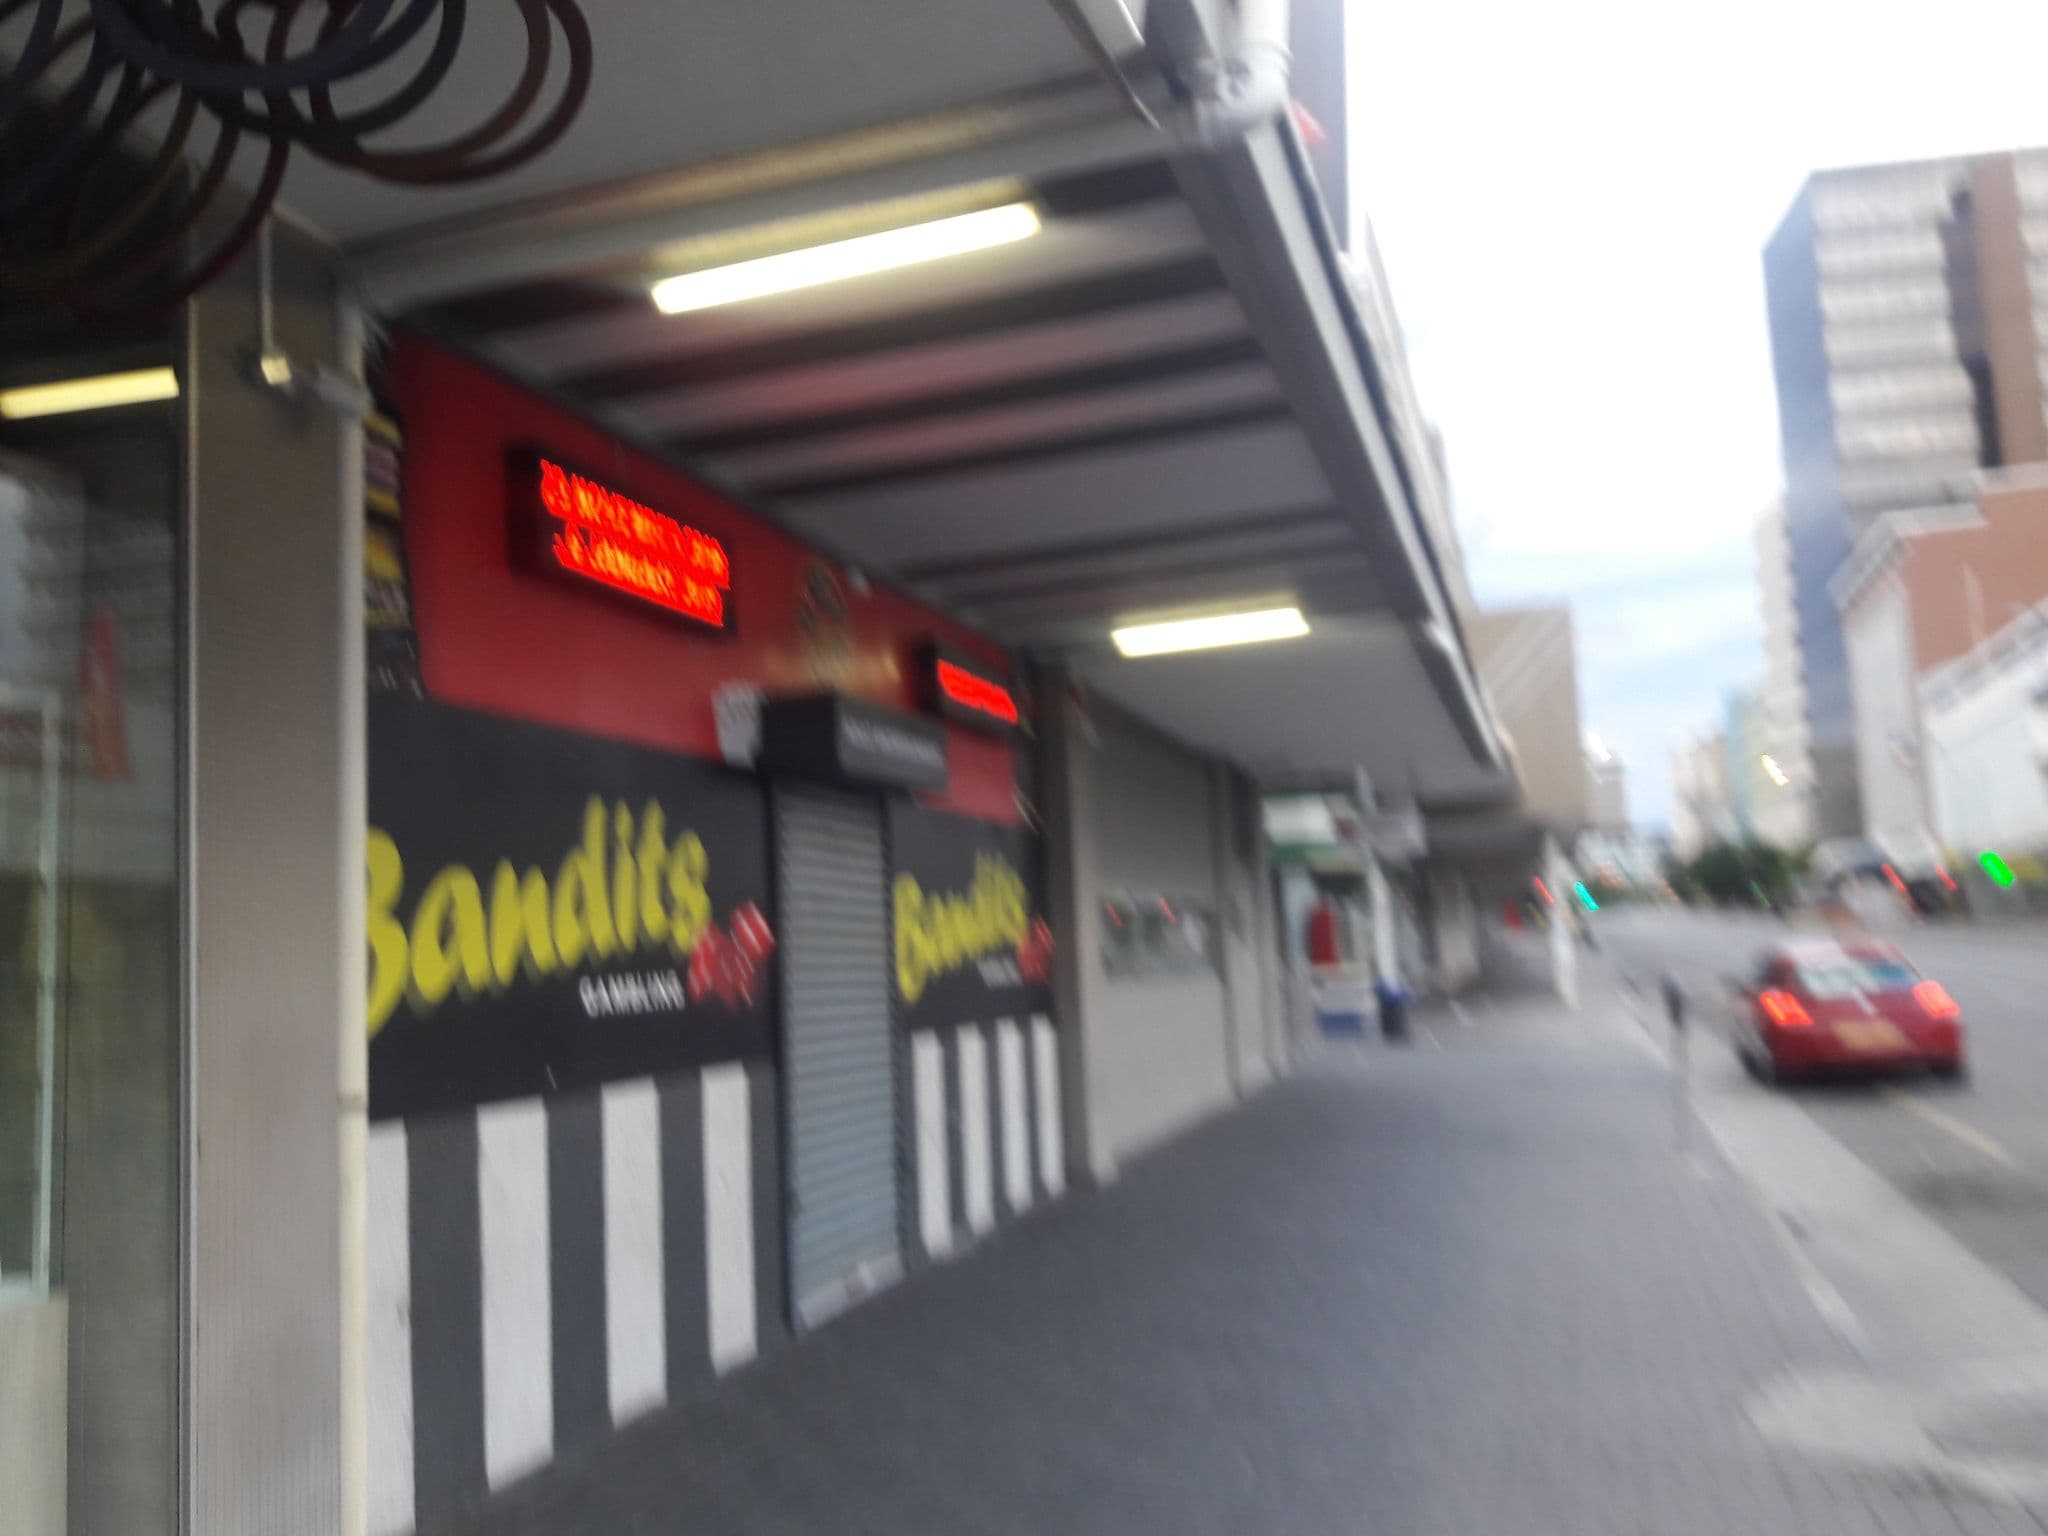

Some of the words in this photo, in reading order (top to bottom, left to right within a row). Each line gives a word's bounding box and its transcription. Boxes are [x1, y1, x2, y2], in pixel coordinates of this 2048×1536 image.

[368, 794, 712, 1038] Bandits
[579, 970, 685, 1017] GAMBLING
[893, 850, 1029, 1005] Bandits
